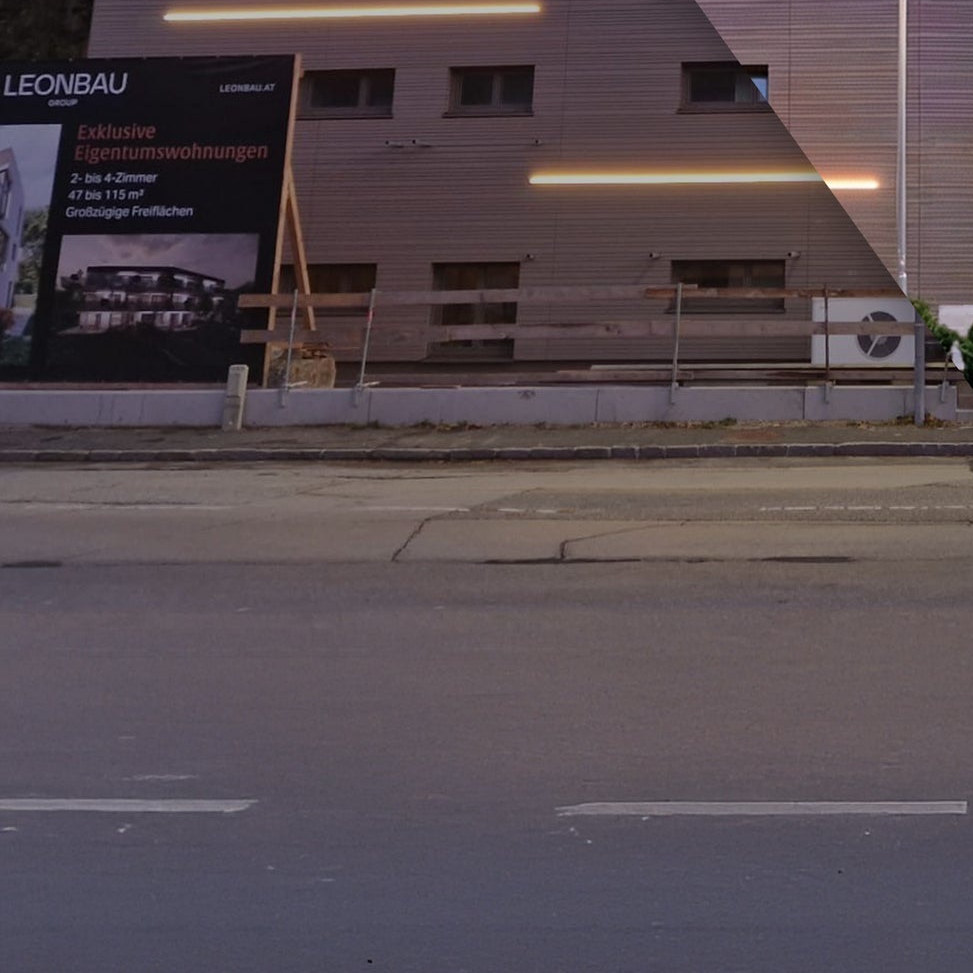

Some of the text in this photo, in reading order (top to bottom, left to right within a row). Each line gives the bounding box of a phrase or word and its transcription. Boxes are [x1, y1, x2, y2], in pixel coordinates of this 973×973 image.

[3, 73, 128, 97] LEONBAU
[219, 83, 276, 93] LEONBAU.AT
[48, 99, 79, 107] GROUP
[77, 124, 157, 141] Exklusive
[74, 143, 268, 165] Eigentumswohnungen
[70, 172, 158, 184] 2- bis 4-Zimmer
[68, 189, 145, 201] 47 bis 115 m²
[65, 205, 194, 219] Großzügige Freiflächen
